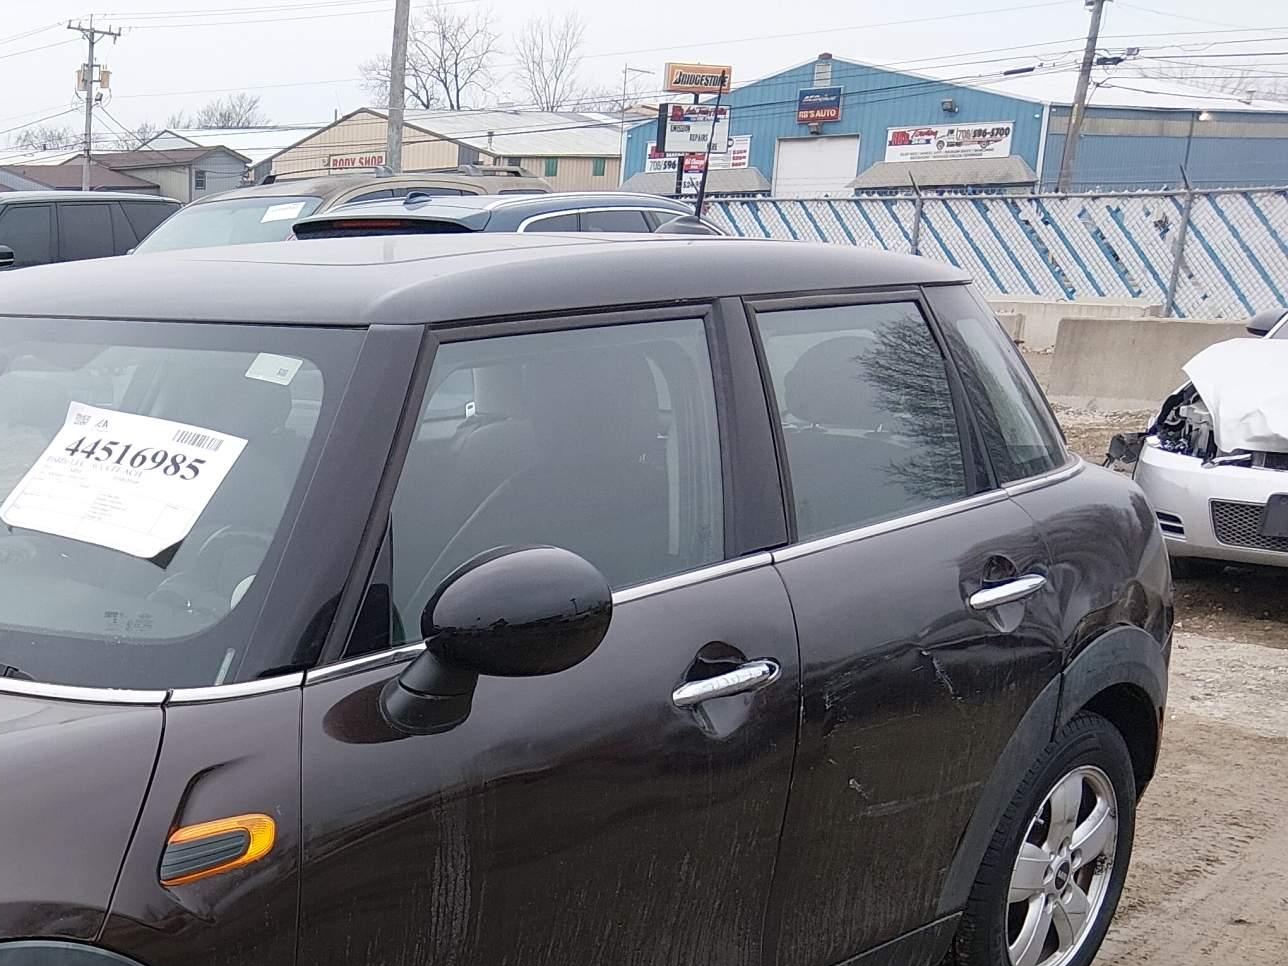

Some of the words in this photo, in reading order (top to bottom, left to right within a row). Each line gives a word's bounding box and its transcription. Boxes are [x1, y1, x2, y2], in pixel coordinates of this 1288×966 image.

[815, 109, 837, 117] AUTO
[332, 158, 355, 170] BODY
[358, 155, 383, 166] SHOP
[65, 436, 207, 480] 44516985
